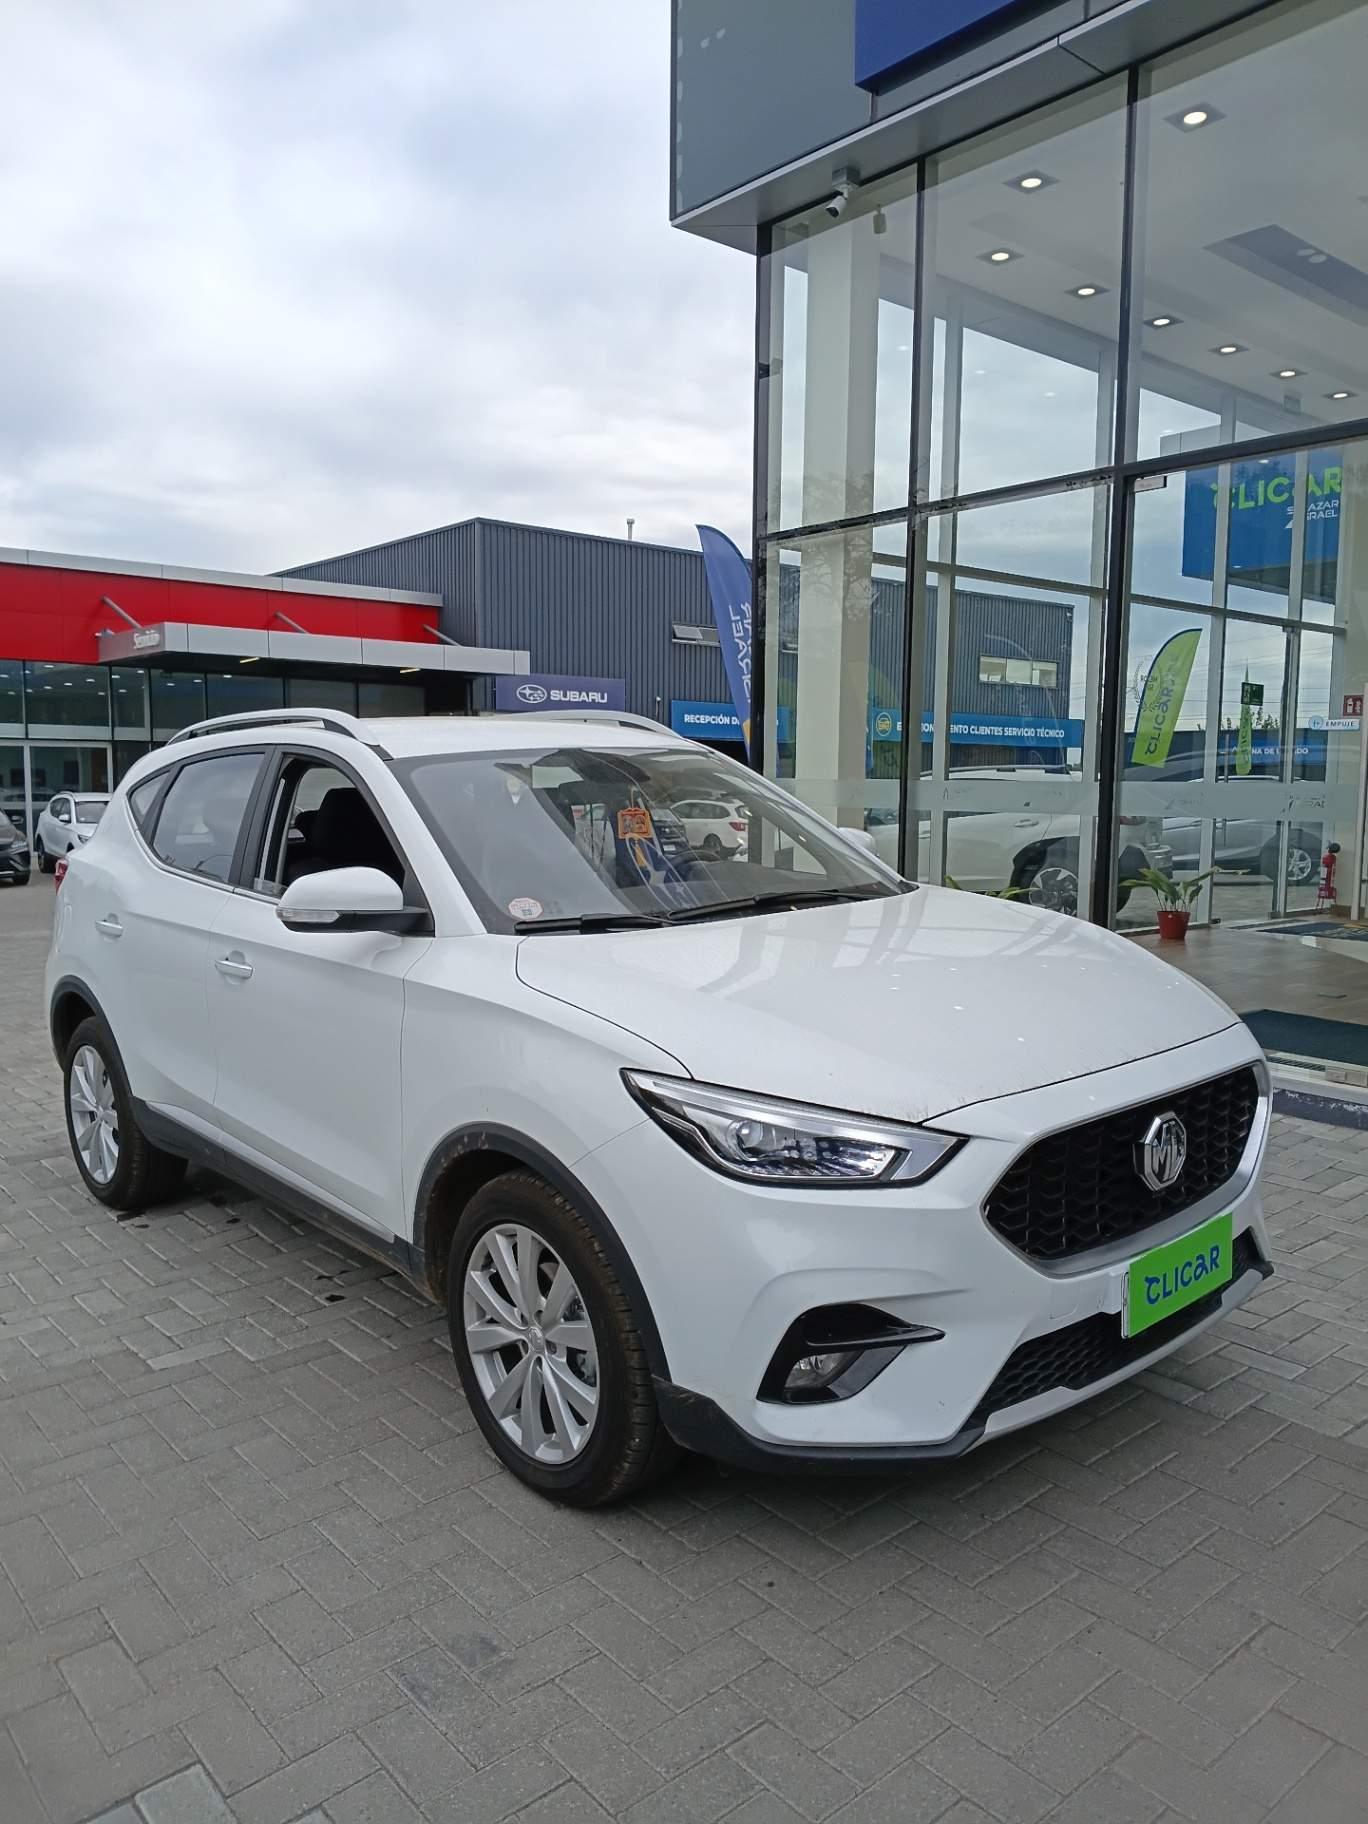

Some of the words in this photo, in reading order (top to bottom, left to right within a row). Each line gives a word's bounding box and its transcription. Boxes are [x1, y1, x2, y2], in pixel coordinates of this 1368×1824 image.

[550, 690, 608, 703] SUBARU
[684, 713, 730, 725] RECEPCIÓN
[1325, 720, 1354, 728] EMPUJE
[969, 726, 1003, 735] CLIENTES
[1004, 727, 1035, 736] SERVICIO
[1036, 726, 1065, 738] TÉCNICO
